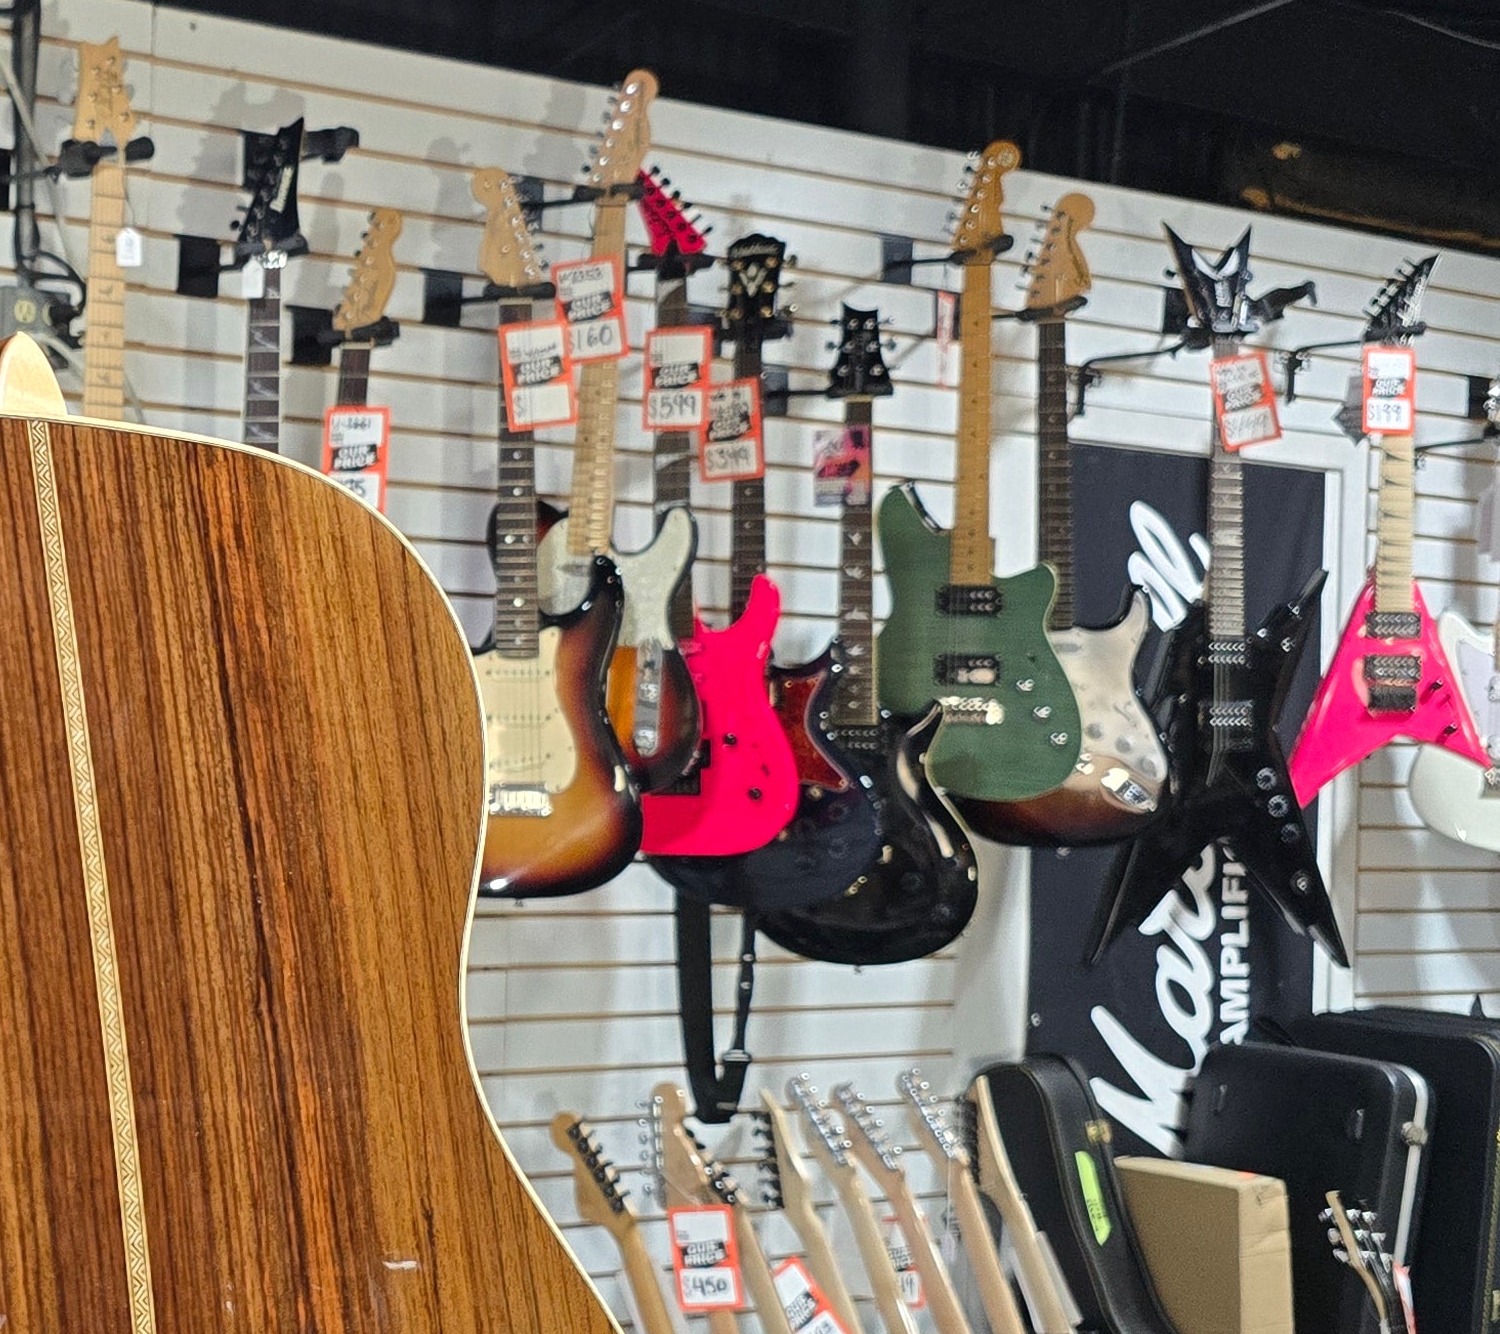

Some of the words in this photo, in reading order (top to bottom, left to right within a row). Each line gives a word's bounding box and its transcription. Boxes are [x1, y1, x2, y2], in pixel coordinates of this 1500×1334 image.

[520, 357, 552, 374] OUR
[516, 366, 560, 385] PRICE
[649, 394, 696, 419] $599
[333, 452, 377, 470] PRICE
[337, 445, 370, 460] OUR
[687, 1240, 718, 1255] OUR
[684, 1250, 727, 1267] PRICE
